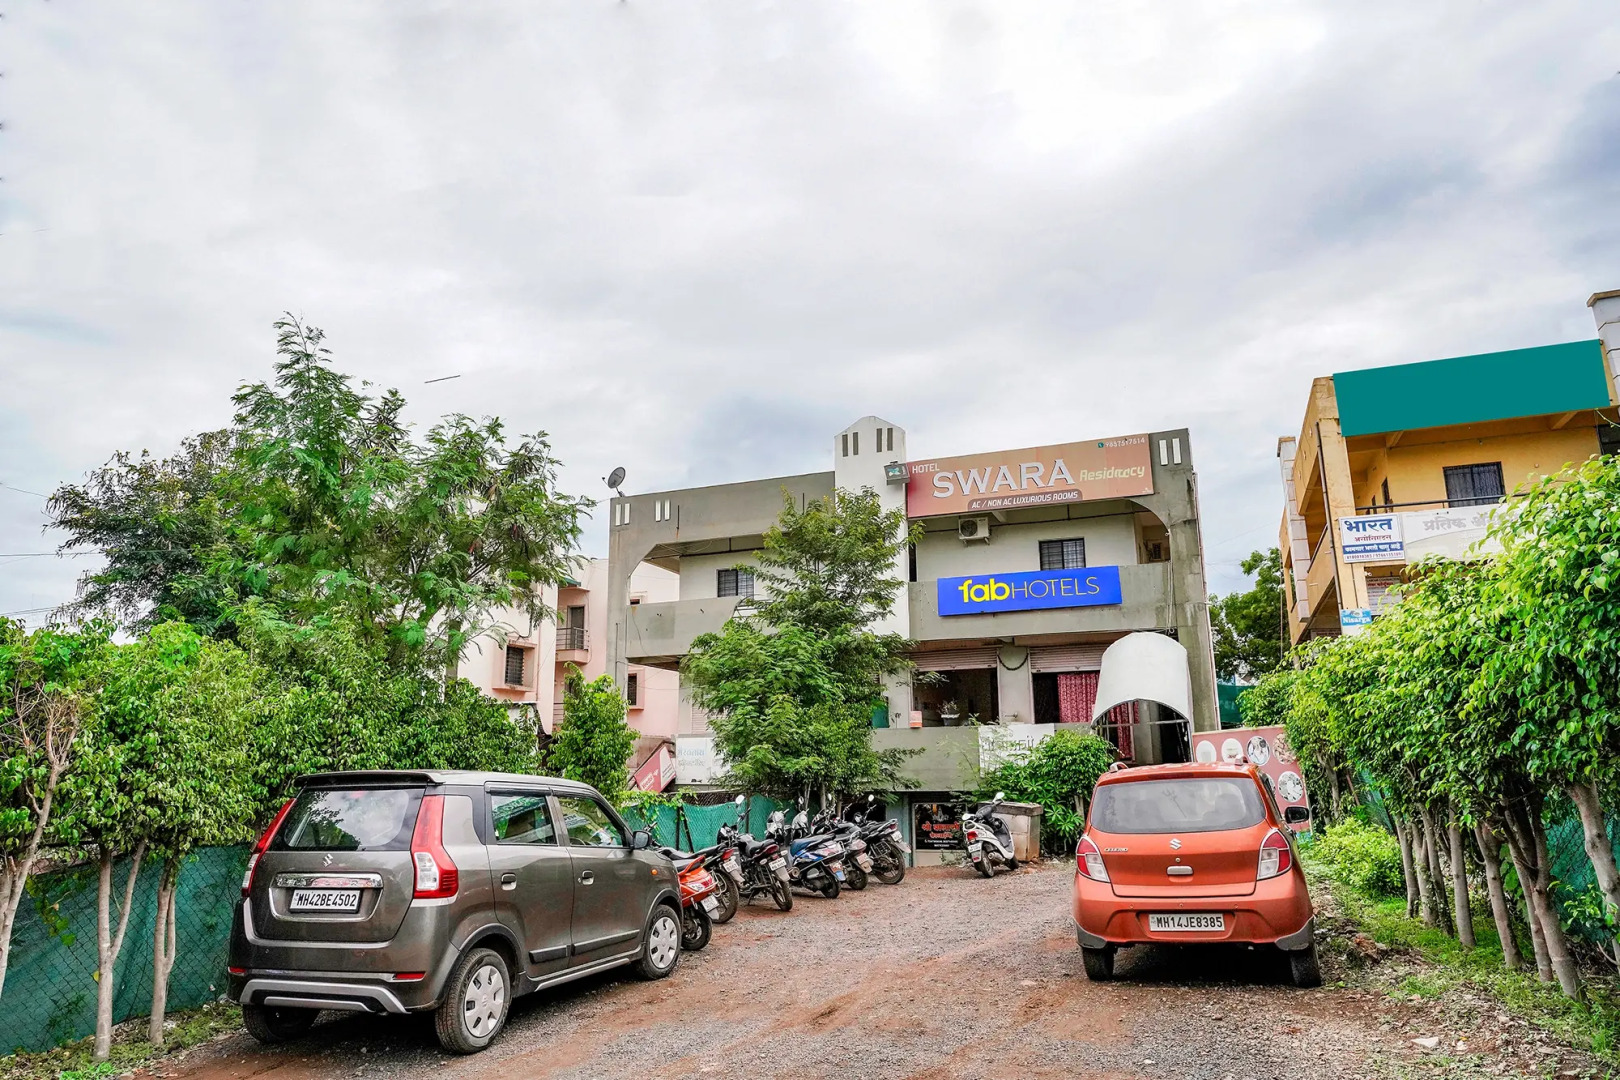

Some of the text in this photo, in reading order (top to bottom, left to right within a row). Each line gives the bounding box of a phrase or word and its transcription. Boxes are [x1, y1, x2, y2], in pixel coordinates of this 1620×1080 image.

[912, 463, 940, 474] HOTEL
[932, 458, 1076, 498] SWARA
[971, 501, 981, 509] AC
[1003, 498, 1012, 506] AC
[1013, 494, 1051, 505] LUXURIOUS
[1053, 491, 1078, 501] ROOMS
[1344, 518, 1393, 532] भारत
[297, 893, 357, 907] MH42BE4502
[1156, 916, 1223, 928] MH14JE8385
